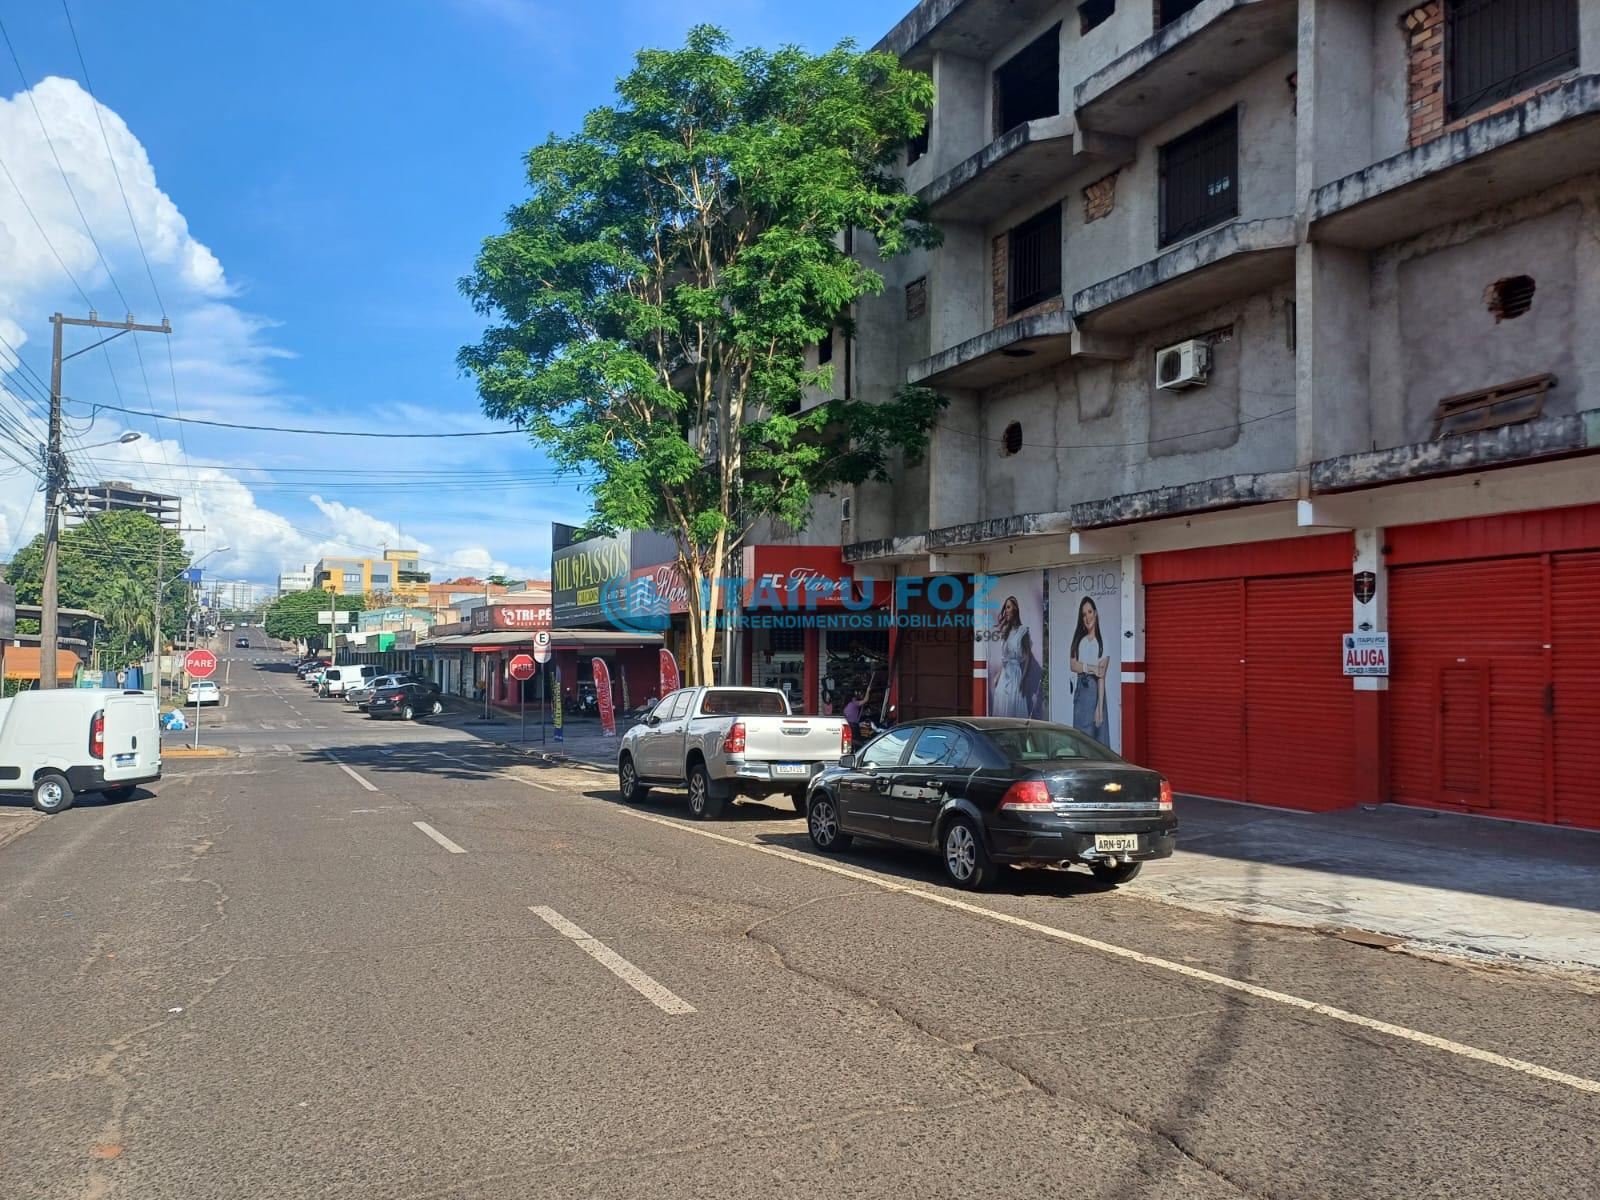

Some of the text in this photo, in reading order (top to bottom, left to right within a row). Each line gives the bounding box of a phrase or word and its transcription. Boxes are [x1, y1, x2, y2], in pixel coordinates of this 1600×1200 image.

[554, 540, 628, 592] MIL PASSOS
[760, 567, 850, 592] FC Flávio
[1057, 568, 1116, 593] beira rio
[515, 607, 552, 621] TRI-PÉ
[539, 633, 546, 643] E
[187, 660, 213, 668] PARE
[1346, 649, 1386, 666] ALUGA
[512, 663, 534, 671] PARE
[1098, 839, 1136, 850] ARN-9741
